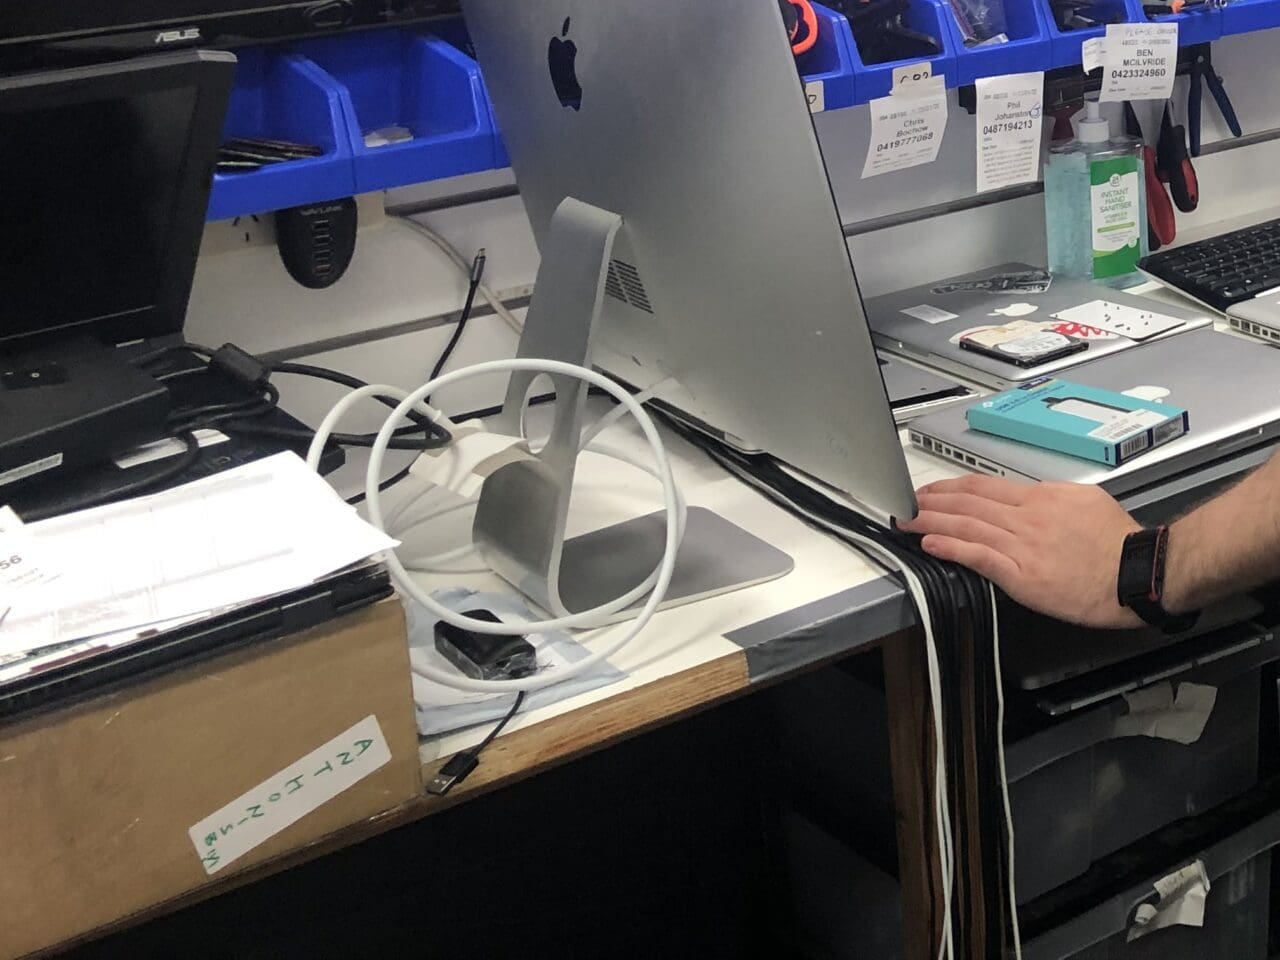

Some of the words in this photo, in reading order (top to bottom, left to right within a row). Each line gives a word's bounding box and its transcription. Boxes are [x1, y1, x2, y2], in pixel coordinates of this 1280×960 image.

[155, 27, 199, 43] ASUS
[1136, 49, 1153, 57] BEN
[1123, 58, 1166, 67] MCILVRIDE
[1111, 68, 1166, 79] 0423324960
[1006, 101, 1021, 110] Phil
[903, 118, 925, 128] Chris
[983, 120, 1033, 135] 0487194213
[1101, 188, 1129, 199] INSTANT
[1105, 196, 1125, 205] HAND
